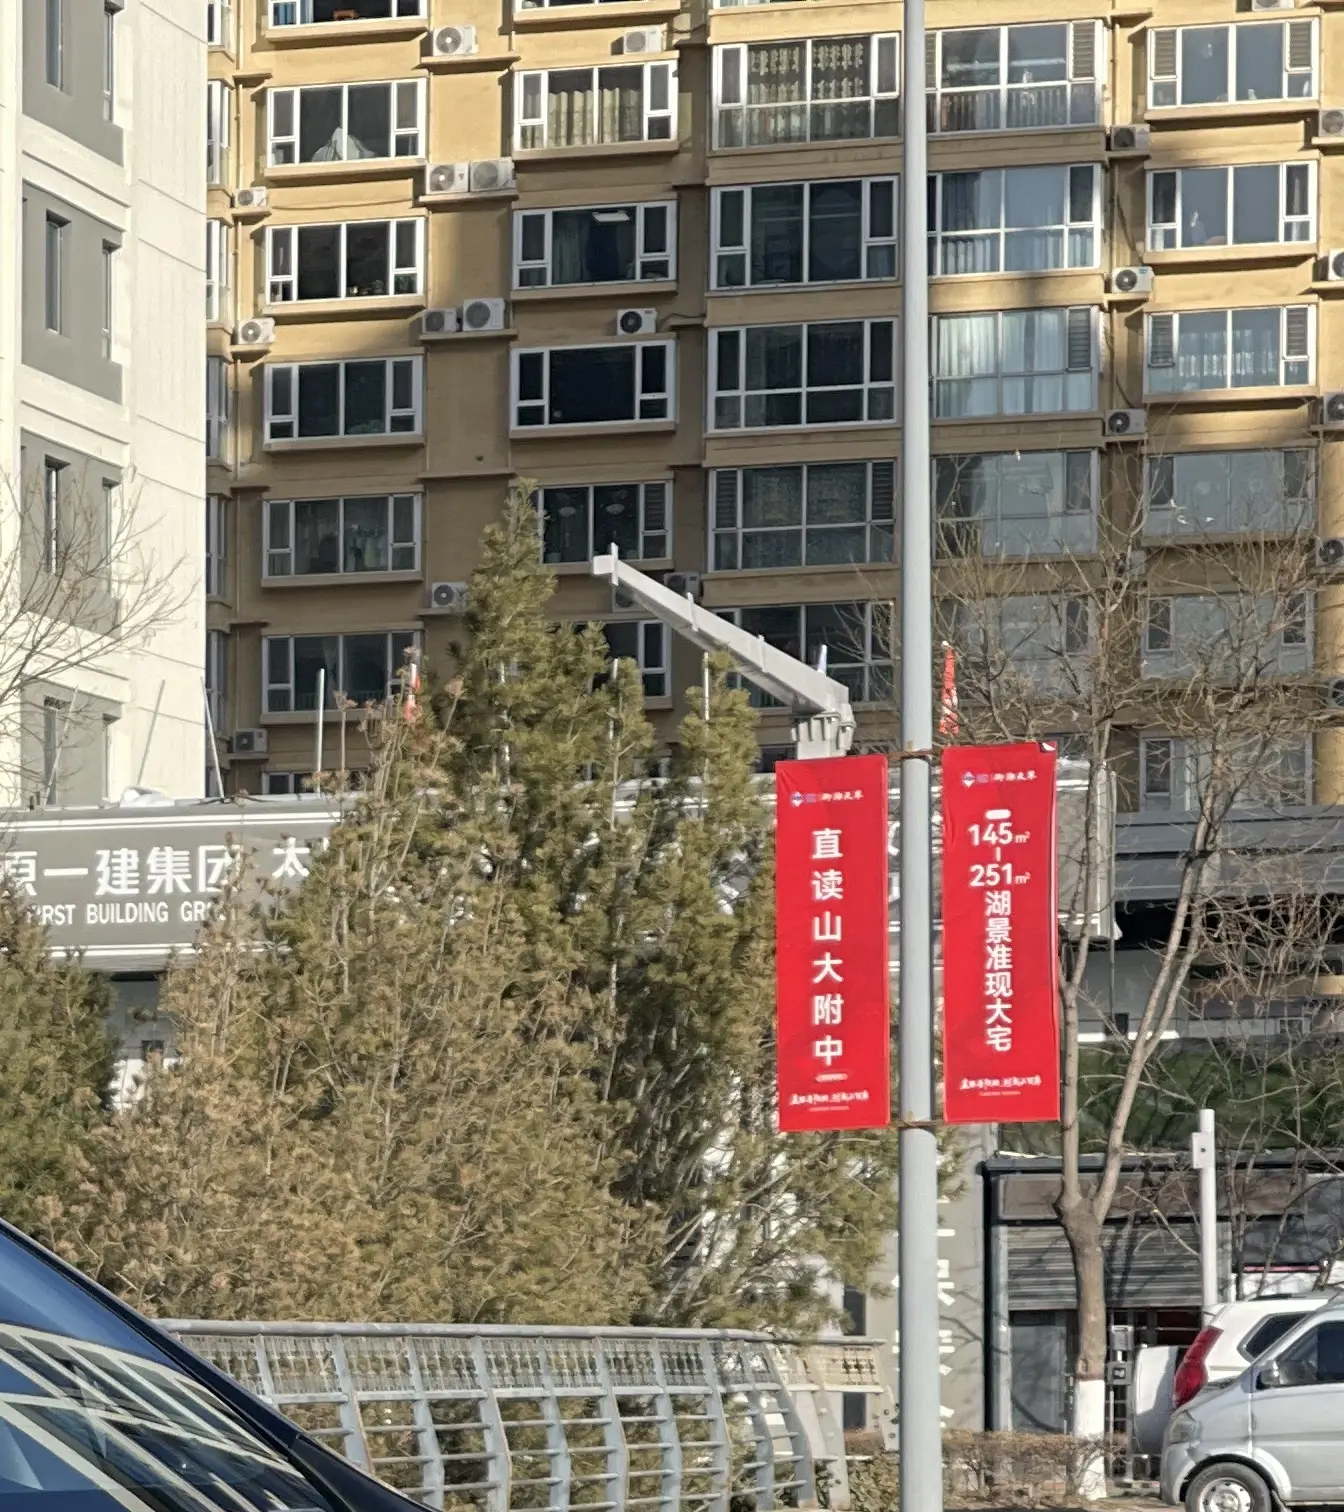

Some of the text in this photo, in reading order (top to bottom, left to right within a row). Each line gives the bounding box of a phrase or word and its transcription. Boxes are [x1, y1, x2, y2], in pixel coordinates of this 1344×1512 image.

[86, 901, 169, 925] BUILDING
[811, 827, 844, 1067] 直读山大附中
[984, 890, 1013, 1053] 湖景准现大宅
